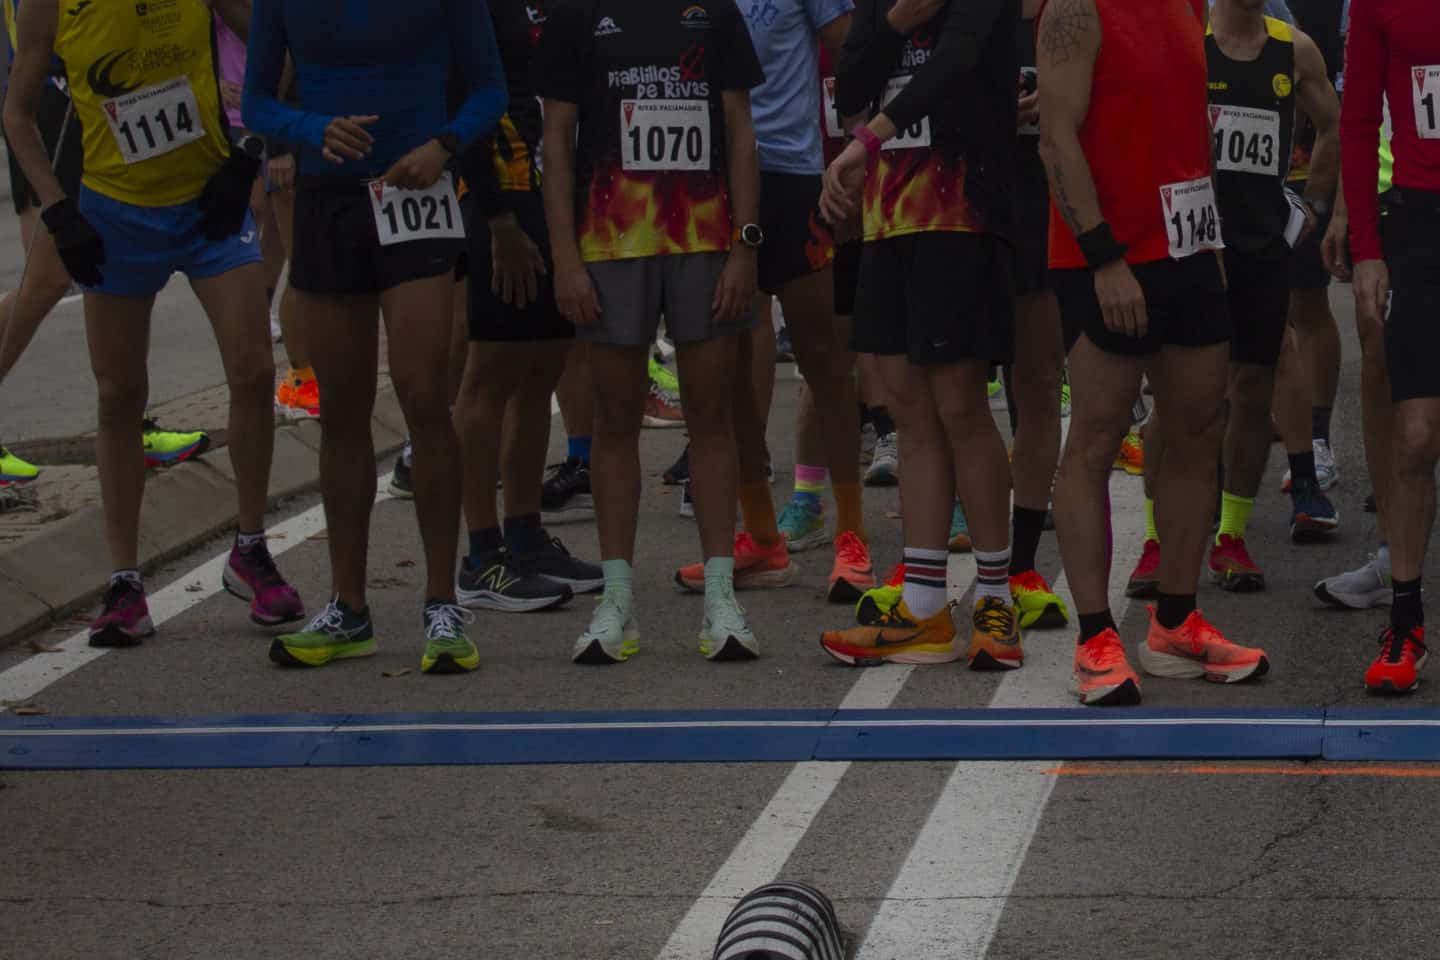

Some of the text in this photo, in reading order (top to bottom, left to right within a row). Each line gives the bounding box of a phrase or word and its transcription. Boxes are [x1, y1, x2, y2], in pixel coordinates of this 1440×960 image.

[119, 102, 193, 154] 1114
[629, 125, 703, 163] 1070
[1215, 128, 1273, 167] 1043
[382, 194, 453, 235] 1021
[1171, 205, 1217, 249] 1148
